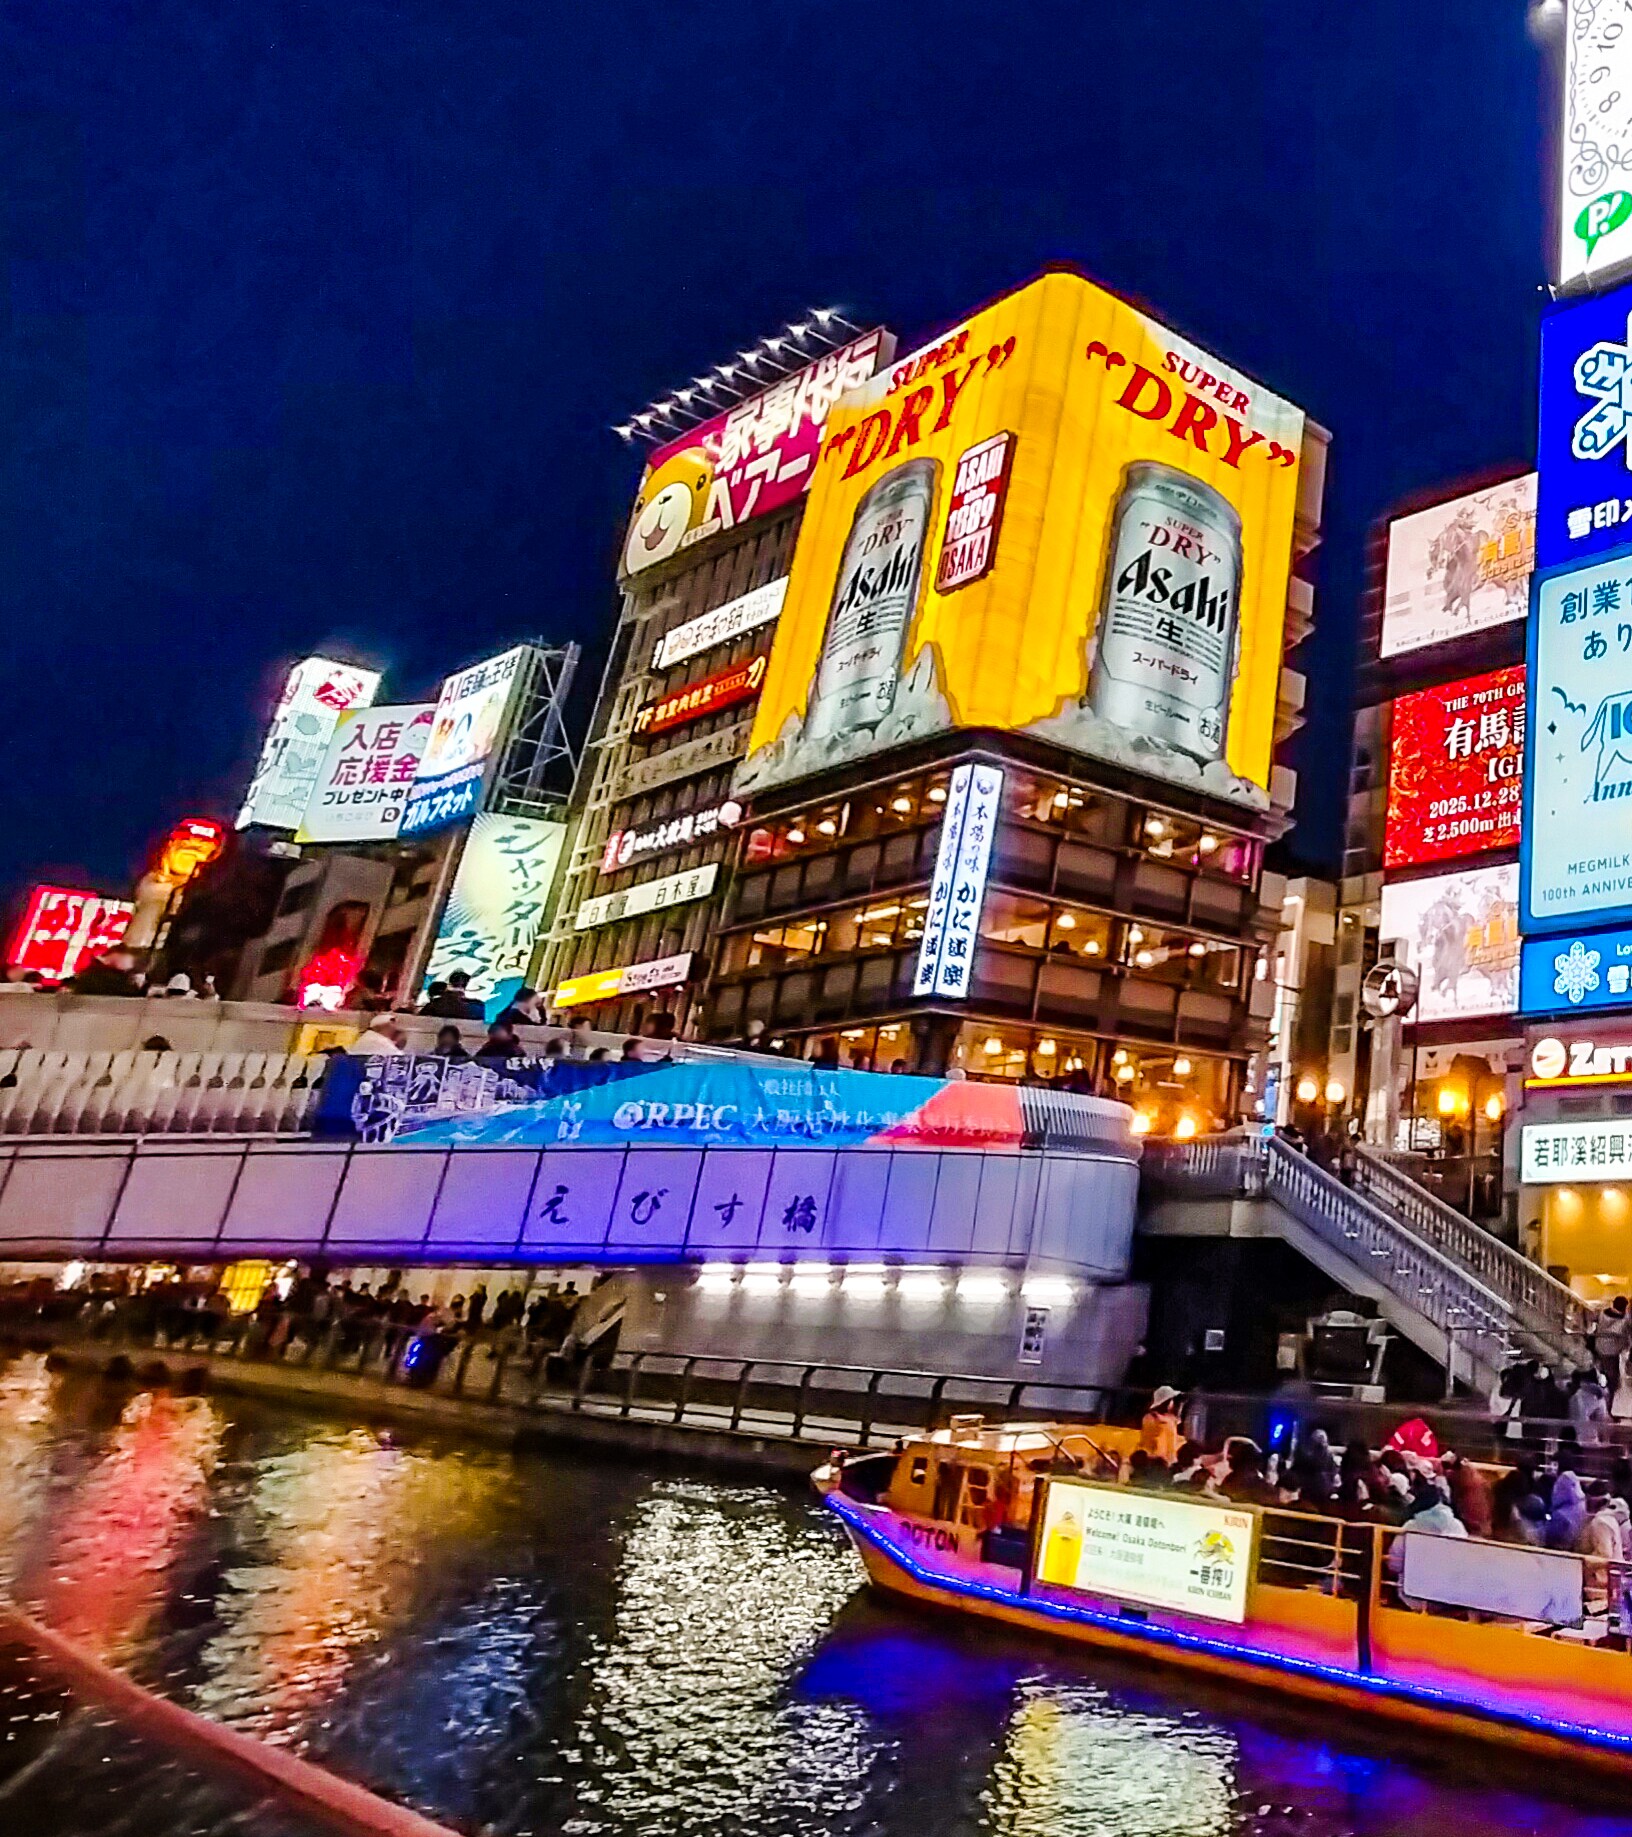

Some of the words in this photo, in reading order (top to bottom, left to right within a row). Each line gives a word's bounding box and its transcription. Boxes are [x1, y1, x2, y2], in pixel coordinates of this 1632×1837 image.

[887, 330, 970, 396] SUPER
[1163, 350, 1250, 415] SUPER
[714, 335, 877, 472] 家事代行
[702, 440, 820, 528] ベアー
[954, 443, 1006, 497] ASAHI
[946, 493, 997, 543] 1889
[1165, 516, 1204, 542] SUPER
[834, 542, 918, 621] Asahi
[938, 535, 986, 584] OSAKA
[1117, 549, 1229, 634] Asahi
[856, 611, 877, 635] 生
[1156, 617, 1184, 646] 生
[1133, 651, 1199, 685] スーパードライ
[1442, 696, 1469, 713] THE
[1473, 688, 1503, 705] 70TH
[341, 722, 404, 752] 入店
[329, 753, 420, 786] 応援金
[1568, 852, 1631, 875] MEGMILK
[493, 823, 555, 972] シャッターは
[655, 874, 701, 906] 白木屋
[1542, 885, 1577, 902] 100th
[540, 1185, 818, 1233] えびす橋
